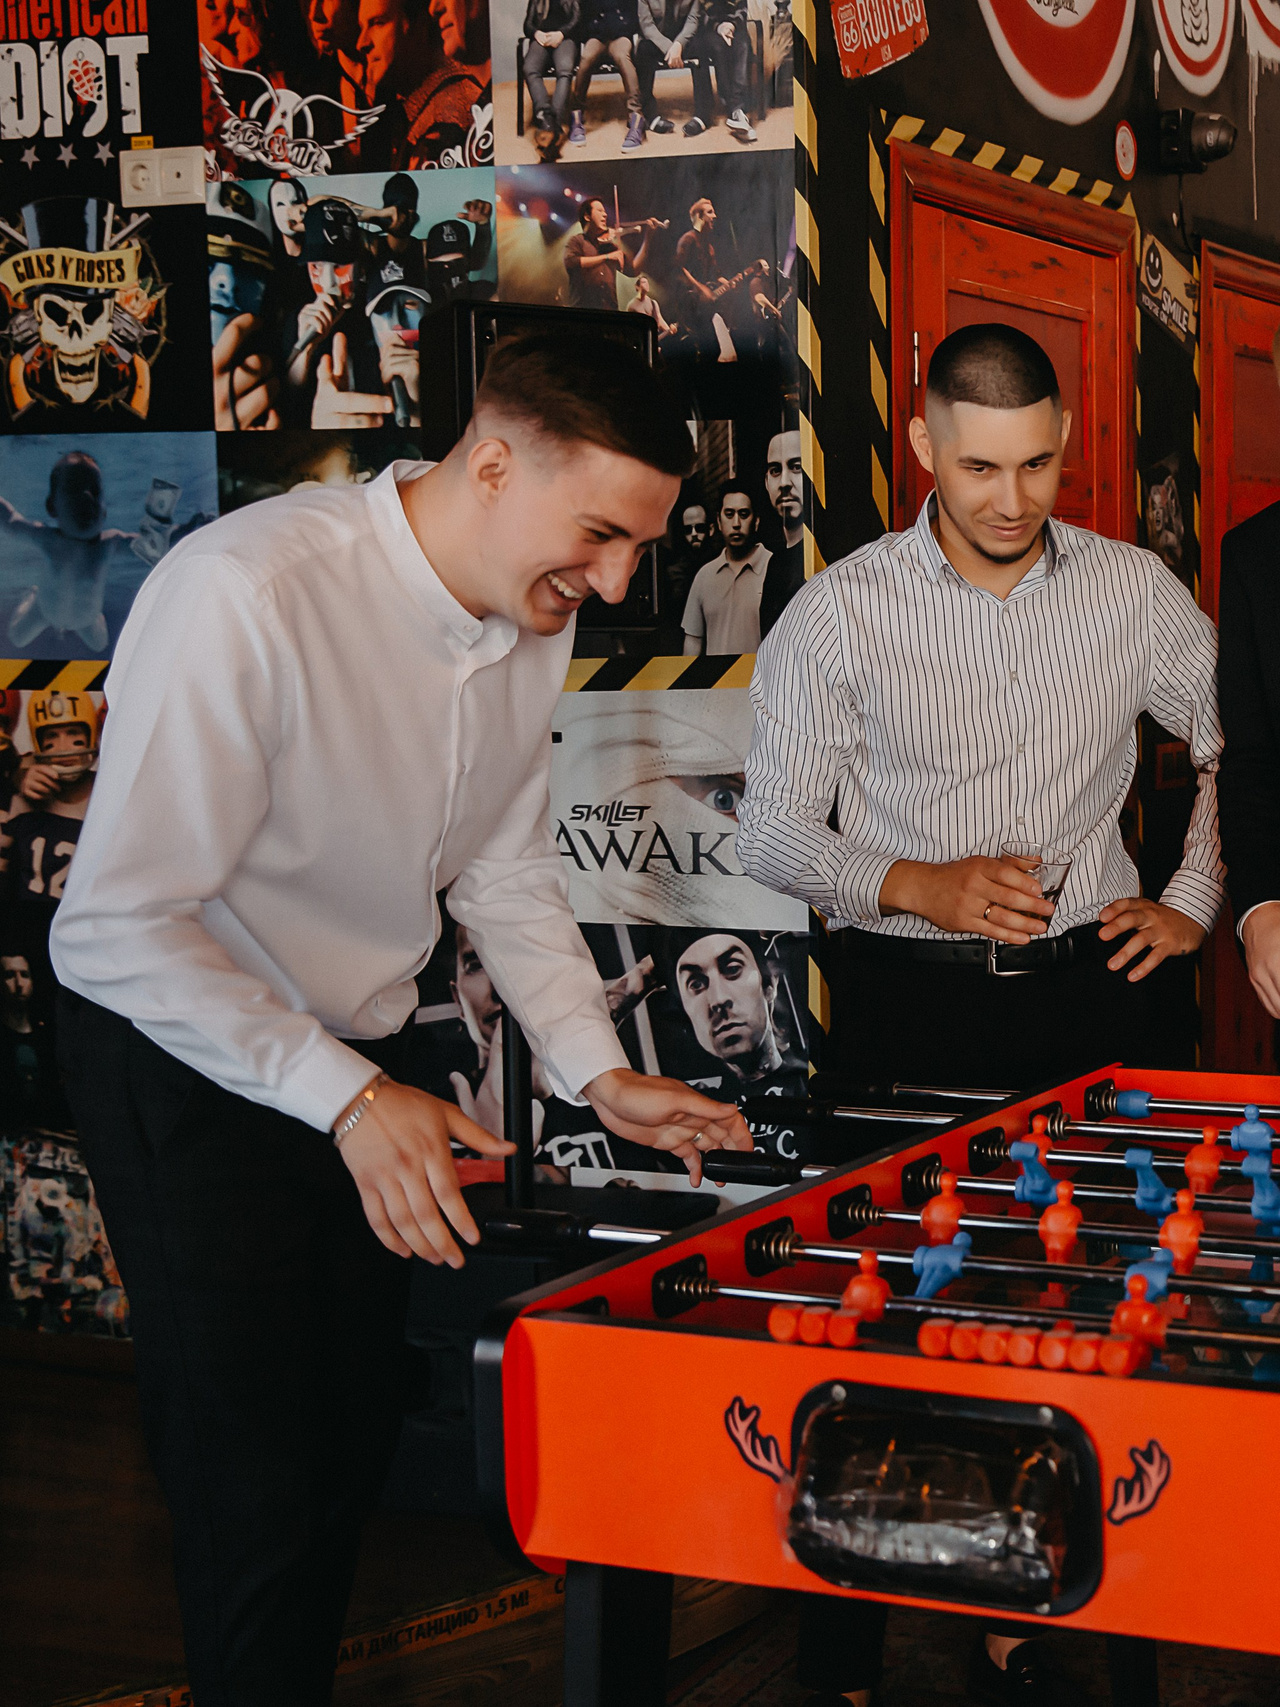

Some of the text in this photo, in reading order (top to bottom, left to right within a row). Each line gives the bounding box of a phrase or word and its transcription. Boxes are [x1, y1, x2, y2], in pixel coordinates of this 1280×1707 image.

[843, 21, 859, 47] 66
[0, 35, 150, 140] DIOT
[12, 253, 55, 284] GUNS
[75, 257, 126, 283] ROSES
[1161, 289, 1189, 334] SMILE
[34, 696, 80, 722] HOT
[568, 800, 652, 827] SKILLET
[28, 836, 77, 899] 12
[556, 818, 750, 877] AWAK
[367, 1608, 480, 1660] ДИСТАНЦИЮ
[485, 1599, 507, 1622] 1,5
